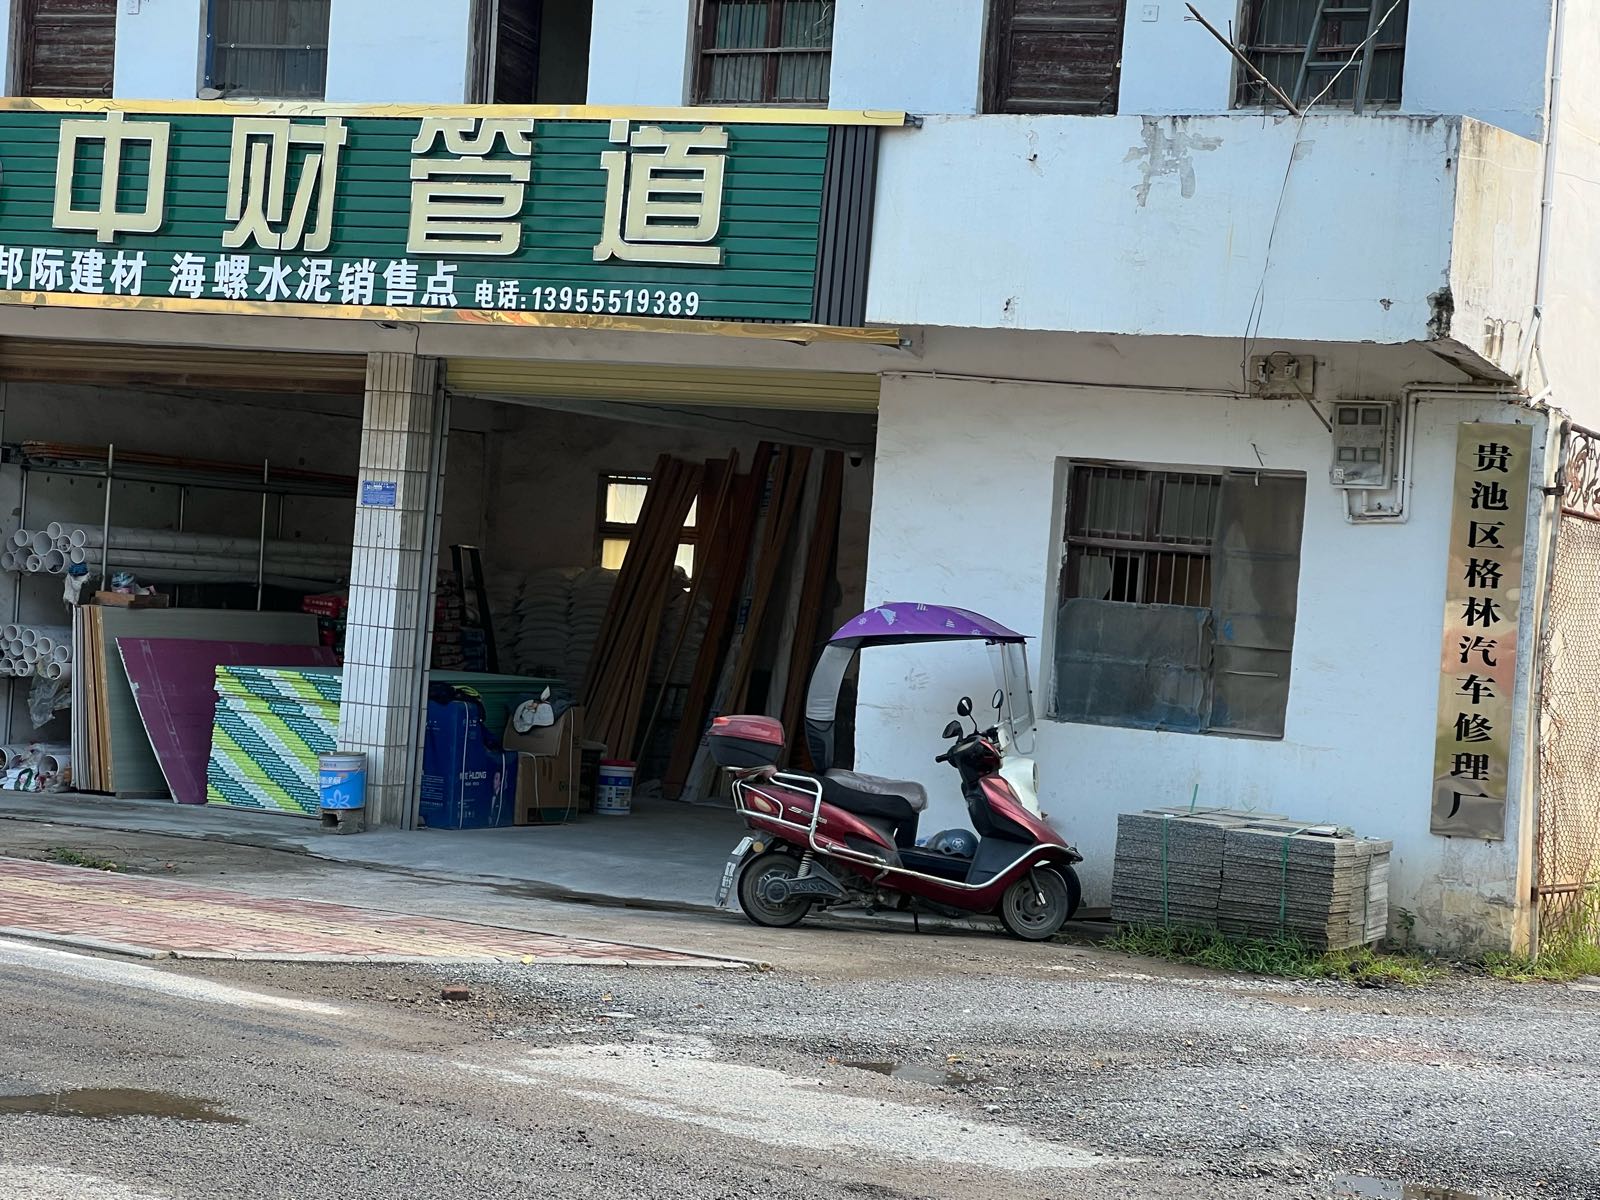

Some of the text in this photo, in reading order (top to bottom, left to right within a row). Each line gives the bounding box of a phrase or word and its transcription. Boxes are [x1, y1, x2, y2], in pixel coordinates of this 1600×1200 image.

[52, 112, 728, 265] 中财管道
[168, 252, 458, 308] 海螺水泥销售点
[1447, 442, 1513, 819] 贵池区格林汽车修理厂
